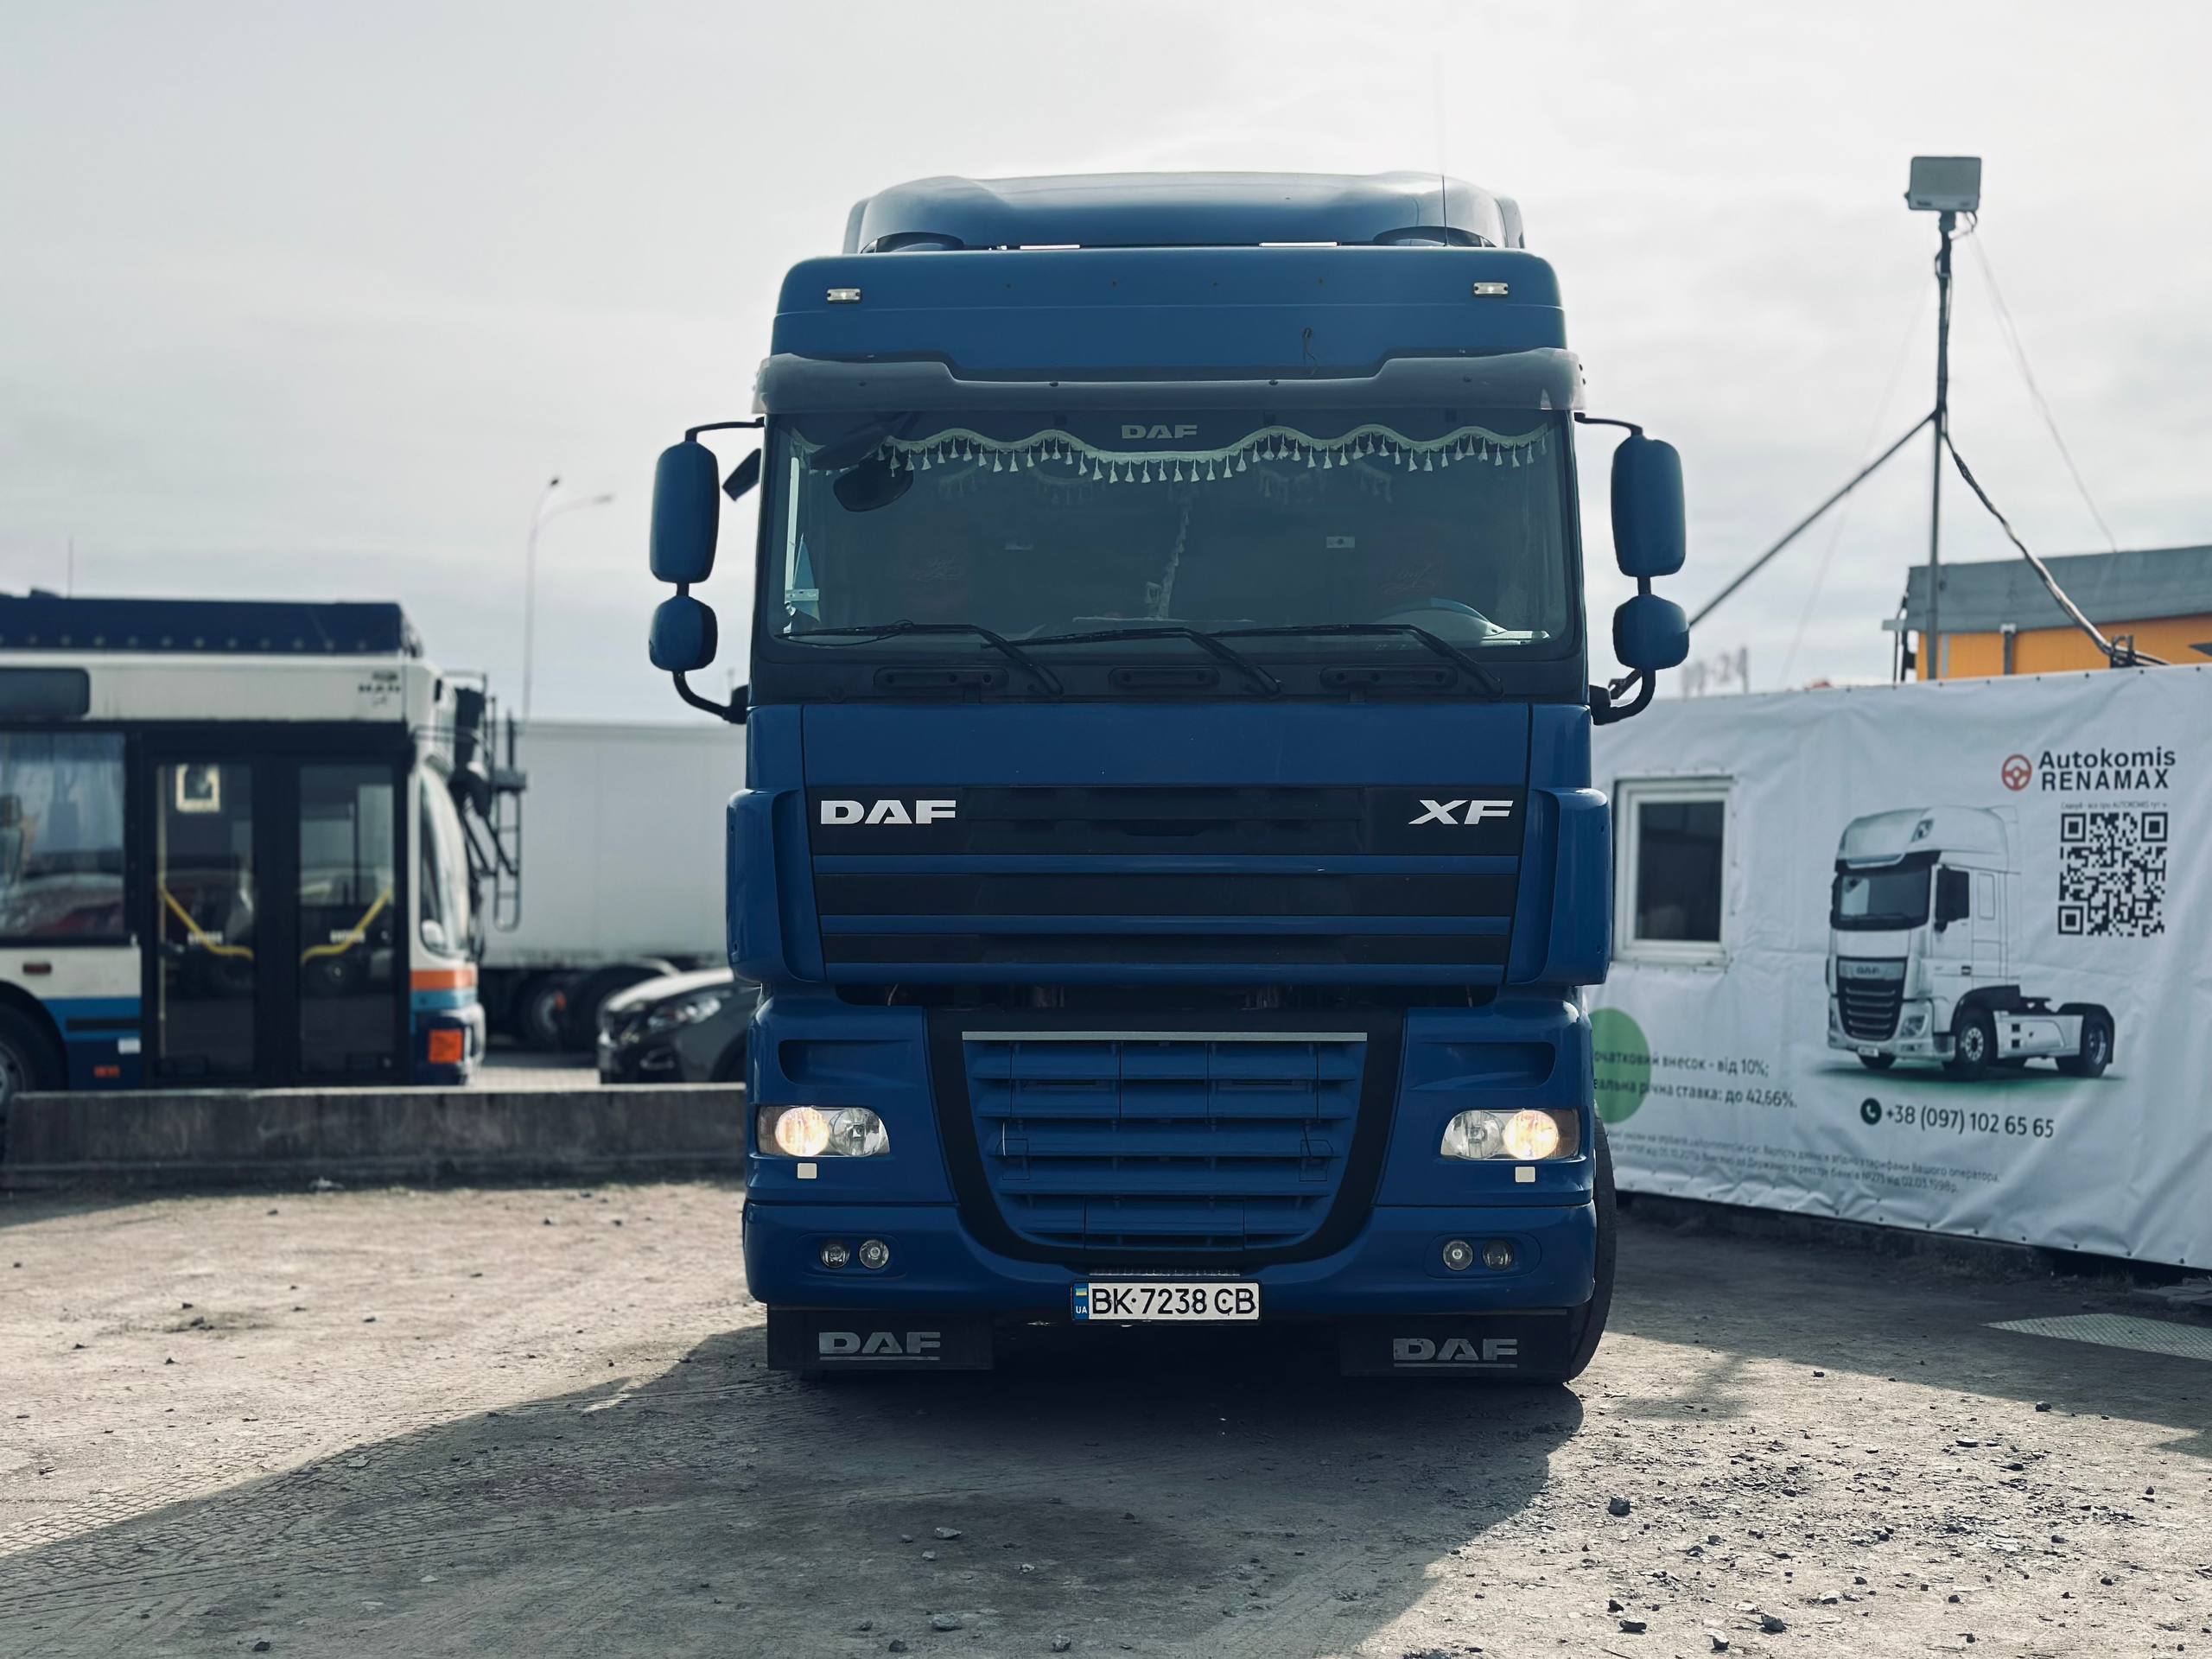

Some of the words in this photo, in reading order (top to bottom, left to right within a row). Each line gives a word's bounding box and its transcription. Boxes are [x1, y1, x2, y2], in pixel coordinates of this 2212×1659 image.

[1122, 424, 1198, 439] DAF
[2038, 746, 2176, 770] Autokomis
[2041, 768, 2169, 791] RENAMAX
[821, 800, 957, 824] DAF
[1408, 799, 1514, 824] XF
[1593, 1051, 1659, 1066] очатковий
[1662, 1055, 1705, 1071] внесок
[1717, 1058, 1738, 1077] від
[1741, 1058, 1770, 1078] 10%;
[1593, 1078, 1636, 1093] еальна
[1725, 1090, 1743, 1105] до
[1885, 1104, 1916, 1125] +38
[1920, 1105, 1966, 1135] (097)
[1970, 1111, 2000, 1134] 102
[2005, 1115, 2028, 1136] 65
[2033, 1117, 2055, 1139] 65
[1092, 1288, 1133, 1314] BK
[1140, 1288, 1207, 1314] 7238
[1214, 1288, 1255, 1315] CB
[819, 1332, 940, 1354] DAF
[1393, 1338, 1517, 1361] DAF
